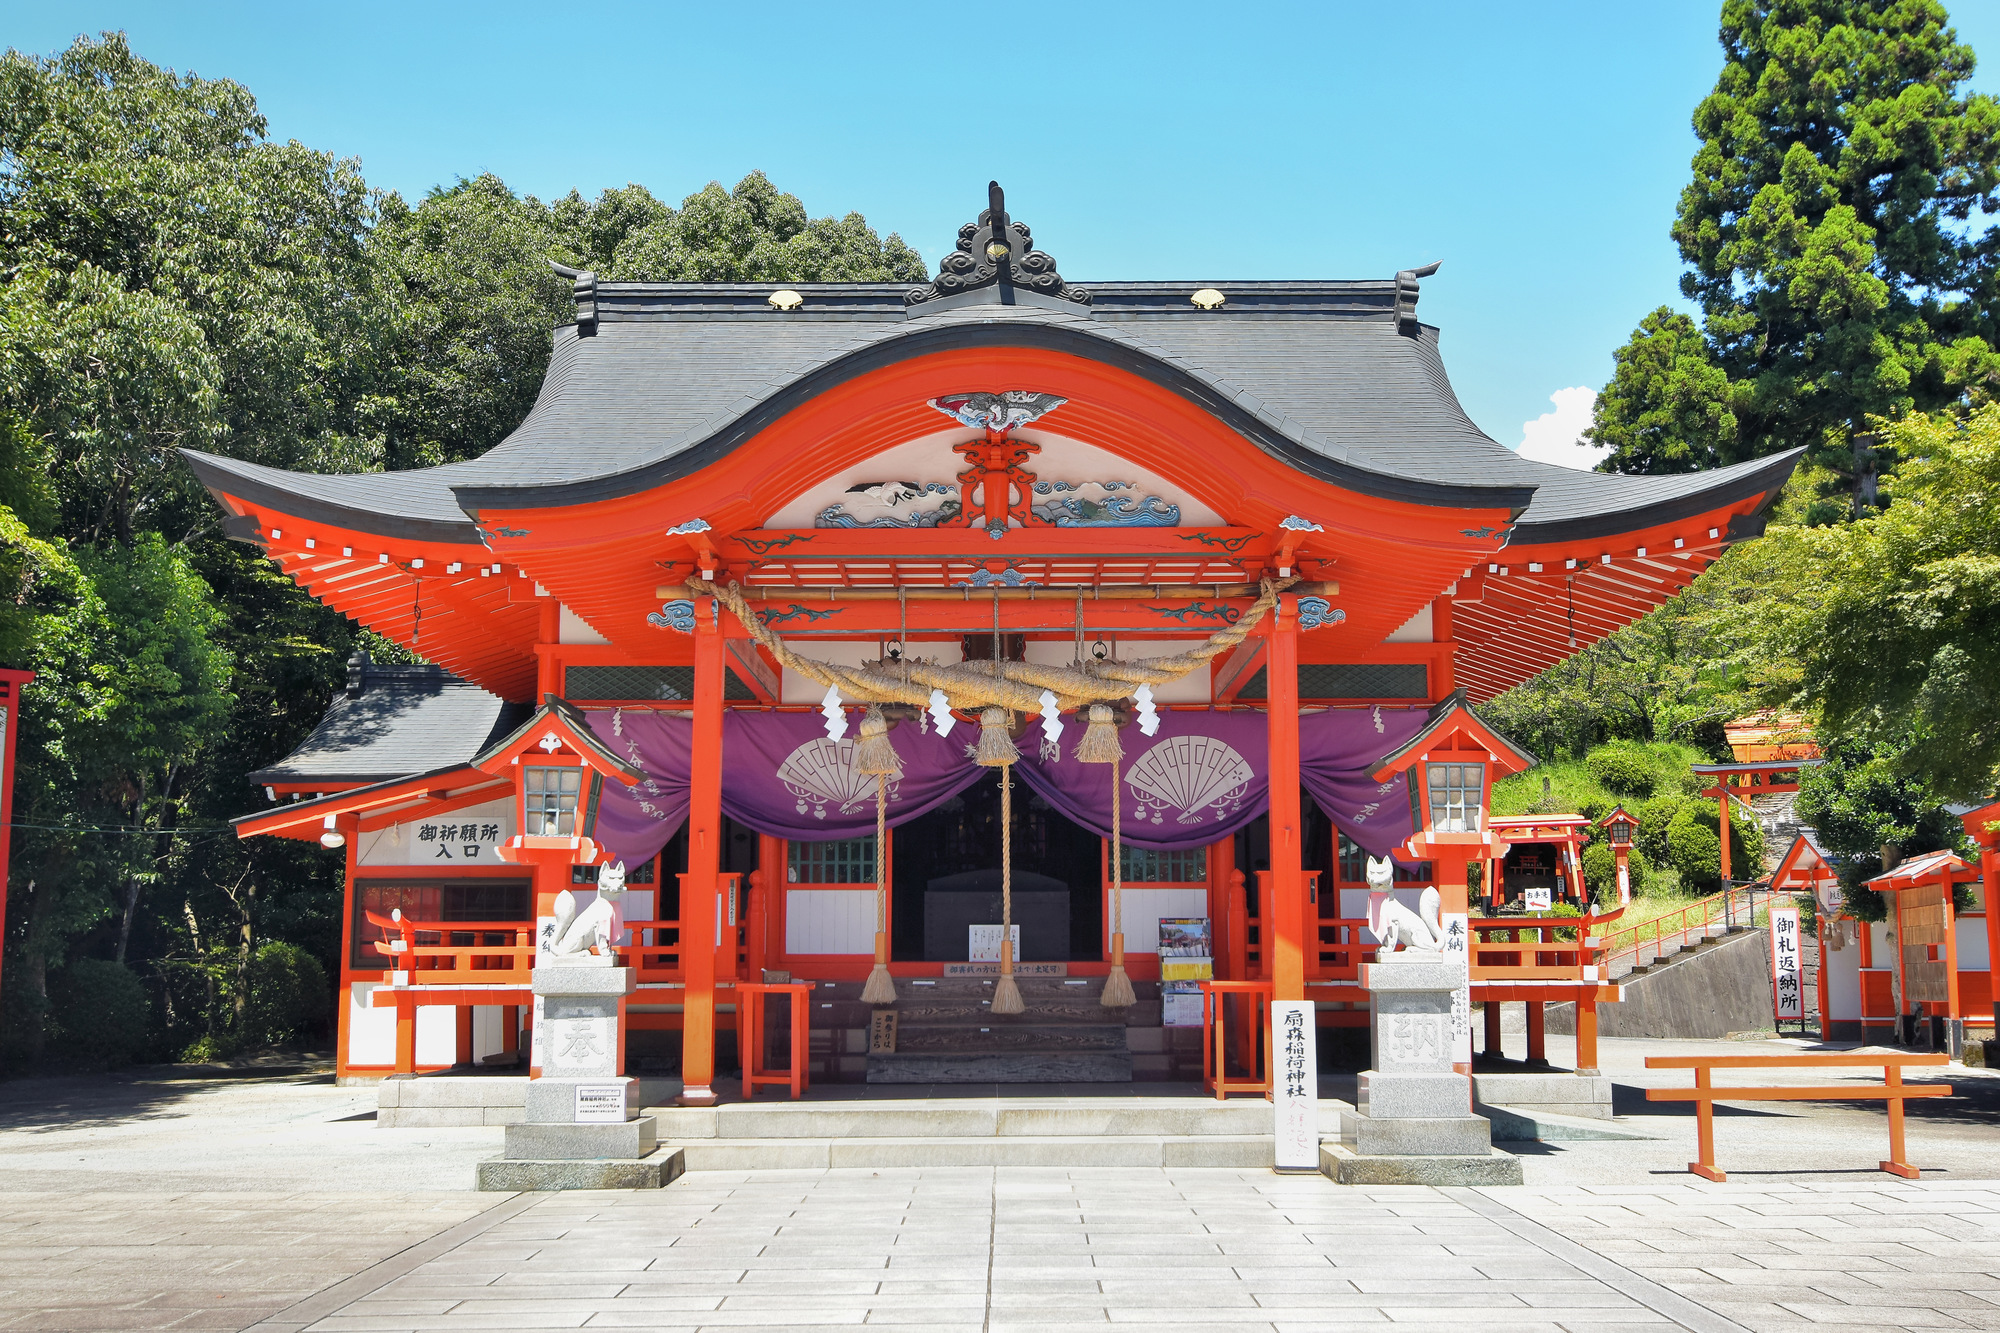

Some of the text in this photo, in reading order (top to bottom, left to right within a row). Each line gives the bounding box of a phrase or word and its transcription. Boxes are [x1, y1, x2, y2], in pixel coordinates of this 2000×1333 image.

[418, 824, 499, 842] 御祈願所
[435, 843, 481, 859] 入口
[1526, 891, 1549, 899] お手洗
[1447, 920, 1465, 952] 奉納
[1776, 917, 1798, 1011] 御札返納所
[558, 1008, 605, 1064] 奉
[873, 1017, 882, 1049] ここから
[1284, 1009, 1307, 1098] 扇森稲荷神社
